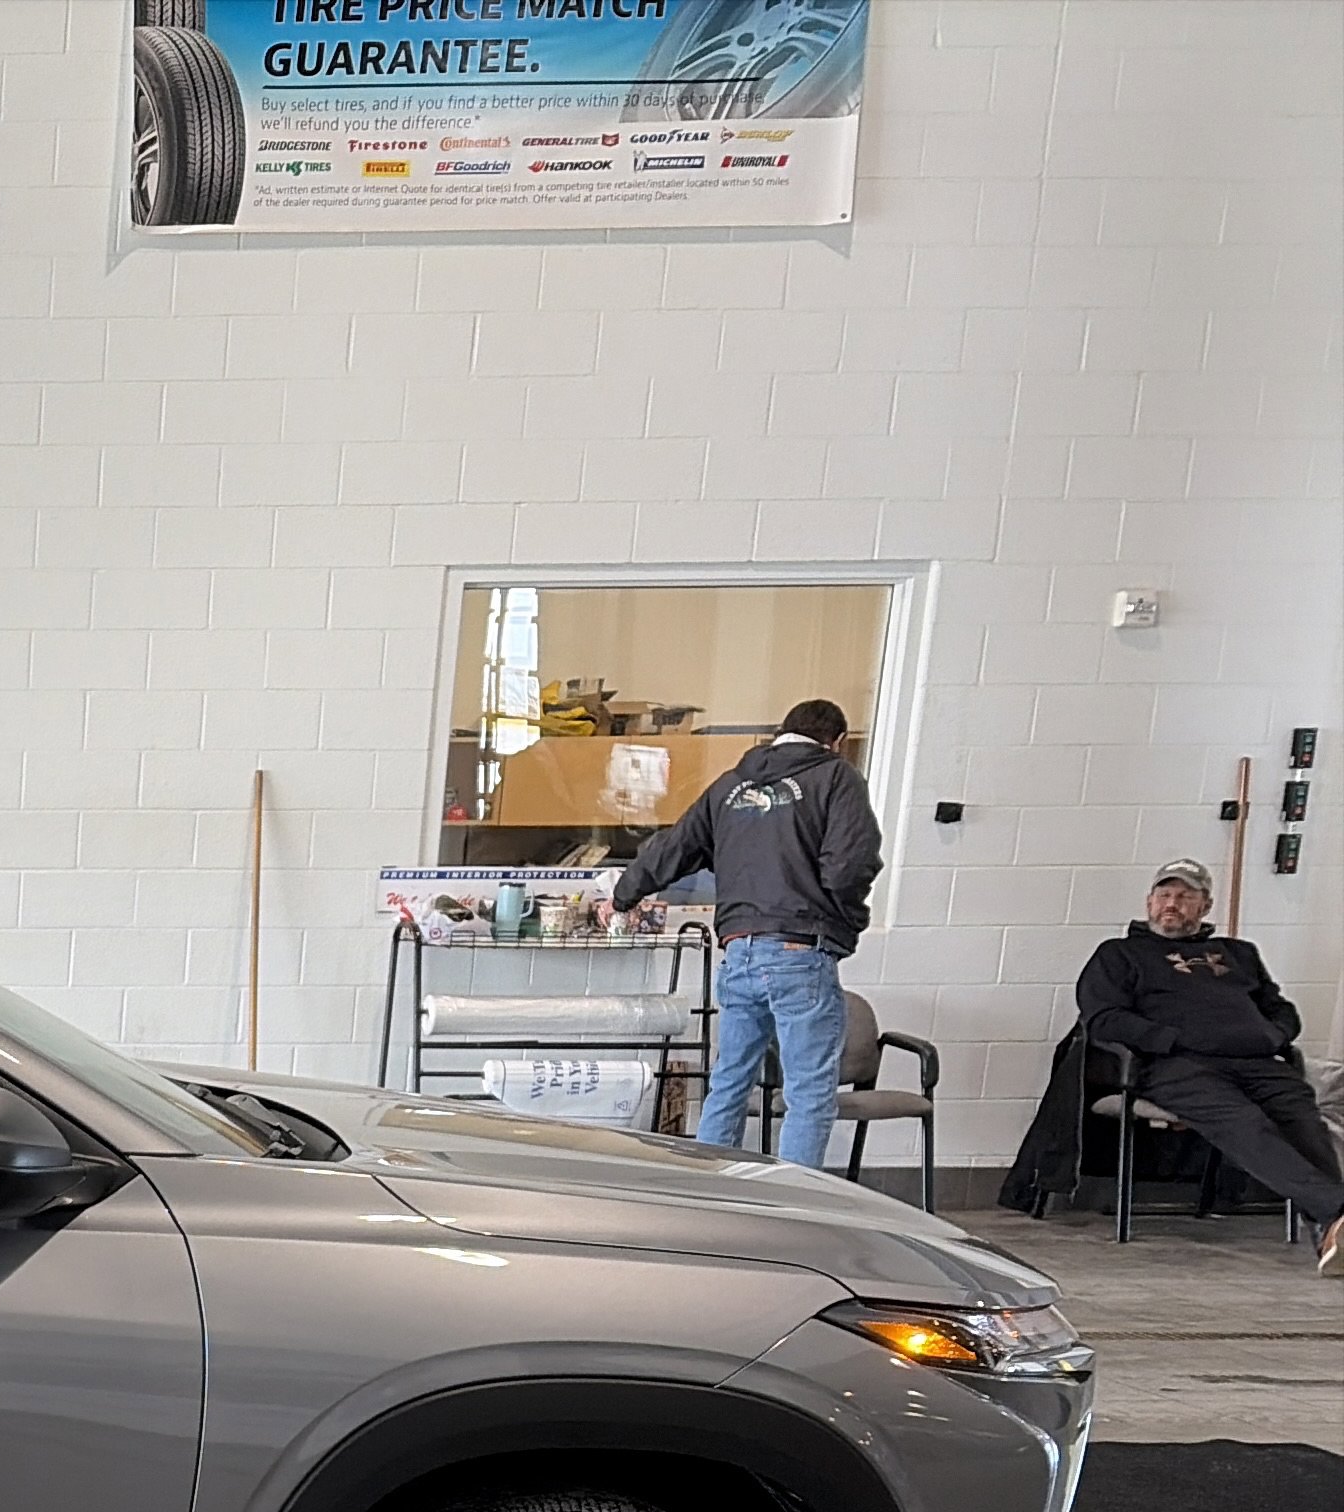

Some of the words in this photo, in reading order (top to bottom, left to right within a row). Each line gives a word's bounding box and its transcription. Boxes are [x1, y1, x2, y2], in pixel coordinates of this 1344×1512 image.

[263, 39, 541, 77] GUARANTEE.
[262, 97, 286, 114] Buy
[290, 97, 329, 112] select
[335, 97, 368, 113] tires,
[372, 96, 398, 111] and
[403, 95, 414, 110] if
[418, 98, 443, 115] you
[448, 94, 475, 110] find
[479, 98, 488, 110] a
[491, 94, 534, 109] better
[538, 94, 571, 112] price
[576, 93, 619, 108] within
[624, 93, 640, 107] 30
[643, 93, 676, 110] days
[679, 92, 695, 105] of
[261, 116, 291, 131] we'll
[295, 116, 339, 131] refund
[344, 119, 370, 134] you
[375, 116, 398, 130] the
[258, 139, 333, 151] BRIDGESTONE
[348, 140, 429, 152] Firestone
[439, 137, 501, 152] Continental
[630, 129, 711, 144] GOODYEAR
[255, 162, 285, 173] KELLY
[304, 162, 332, 172] TIRES
[435, 160, 511, 172] BFGoodrich
[647, 157, 703, 167] MICHELIN
[731, 156, 778, 167] UNIROYAL
[276, 184, 309, 194] written
[311, 184, 350, 194] estimate
[364, 184, 398, 193] Internet
[400, 184, 428, 194] Quote
[431, 184, 444, 193] for
[446, 183, 483, 193] identical
[514, 182, 536, 192] from
[546, 182, 594, 193] competing
[597, 181, 611, 190] tire
[687, 178, 720, 188] located
[721, 177, 750, 187] within
[766, 177, 790, 186] miles
[254, 199, 263, 207] of
[266, 198, 280, 207] the
[283, 198, 311, 207] dealer
[313, 198, 349, 208] required
[351, 197, 381, 208] during
[383, 198, 427, 208] guarantee
[430, 196, 456, 207] period
[461, 195, 475, 205] for
[480, 195, 498, 206] price
[533, 194, 557, 204] Offer
[559, 194, 580, 203] valid
[584, 194, 593, 203] at
[596, 192, 653, 204] participating
[382, 871, 438, 879] PREMIUM
[445, 871, 504, 879] INTERIOR
[509, 870, 585, 879] PROTECTION
